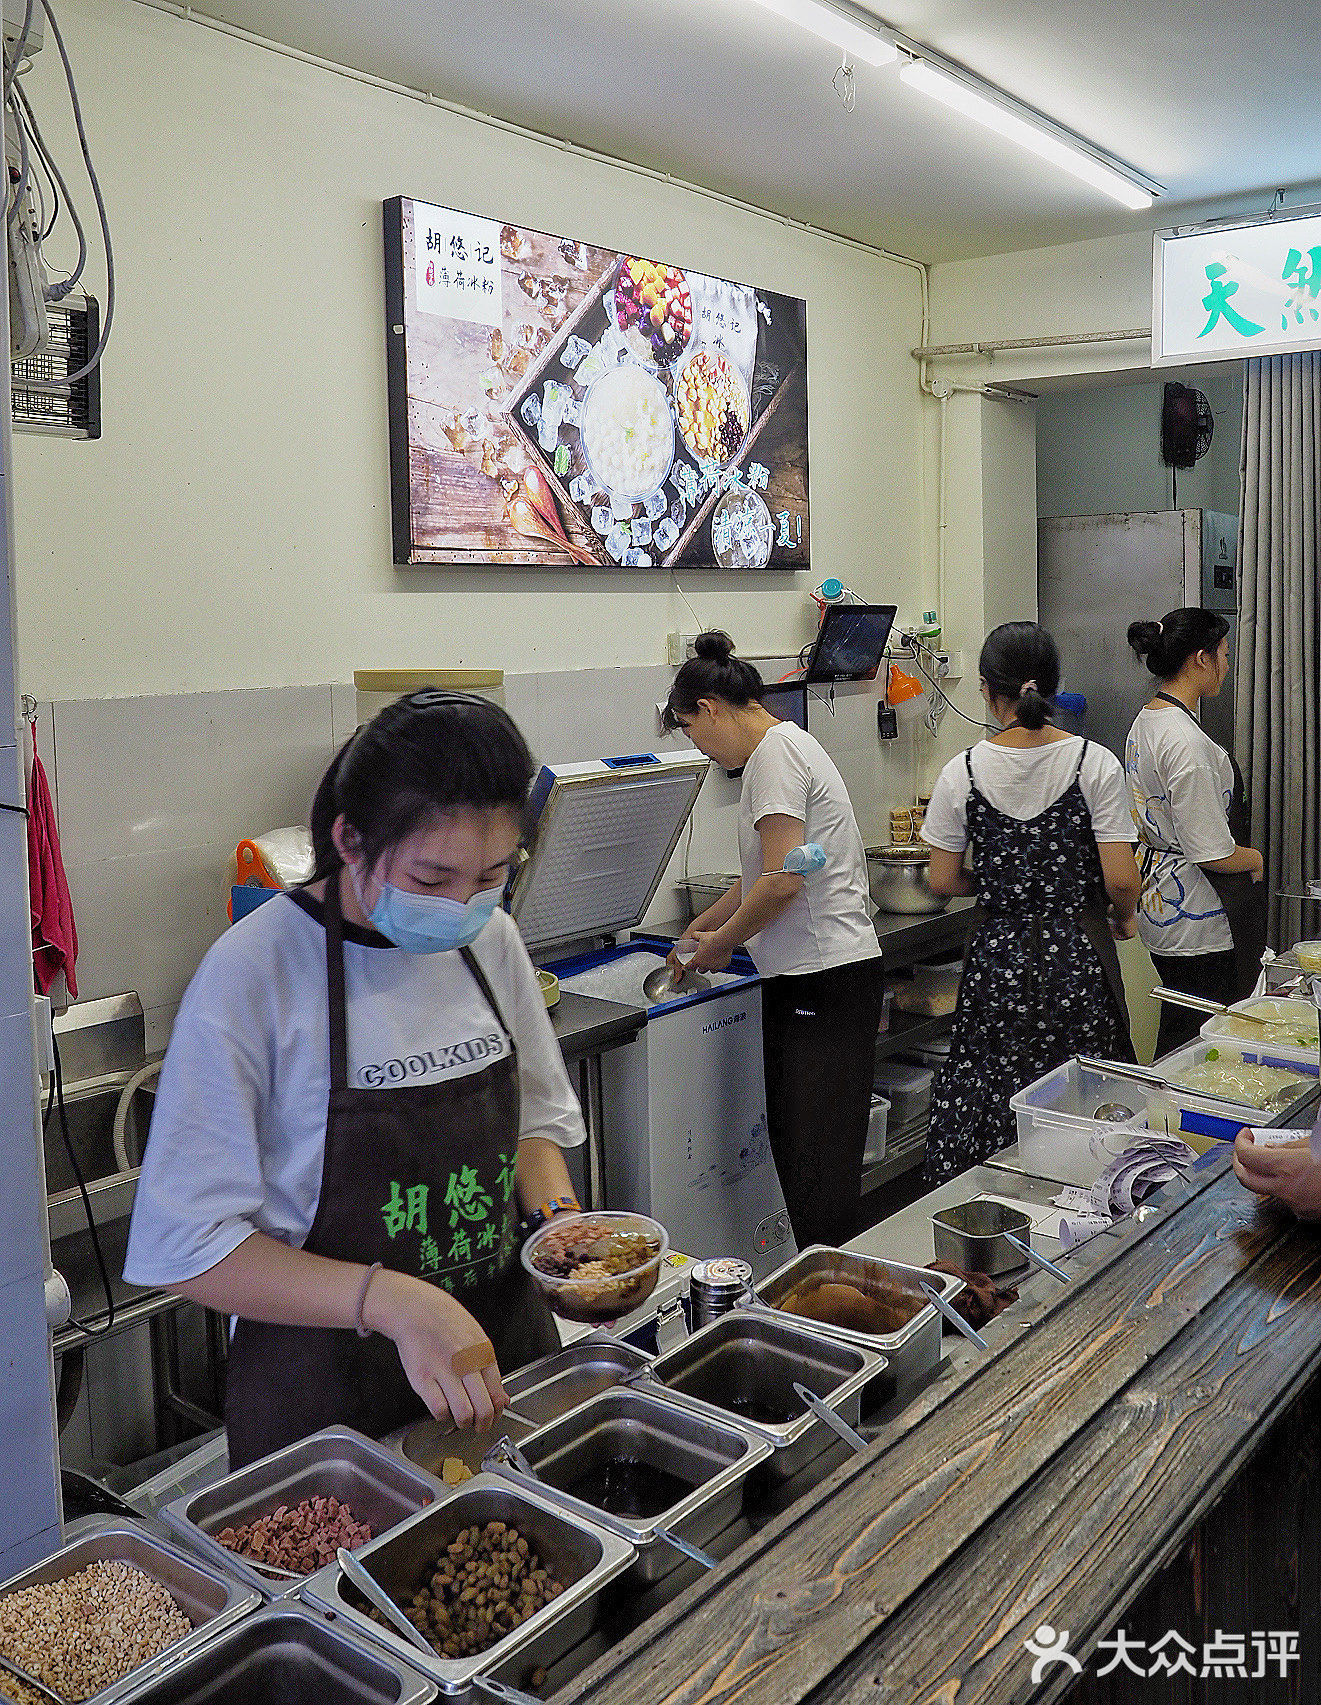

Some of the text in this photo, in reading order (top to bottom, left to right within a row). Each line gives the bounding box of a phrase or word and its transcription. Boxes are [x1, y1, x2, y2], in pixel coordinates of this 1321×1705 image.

[426, 228, 494, 265] 胡悠记
[438, 266, 494, 295] 薄荷冰粉
[701, 306, 741, 334] 胡悠记
[702, 1016, 734, 1035] HAILANG
[357, 1033, 504, 1088] COOLKIDS
[420, 1215, 513, 1271] 薄荷冰
